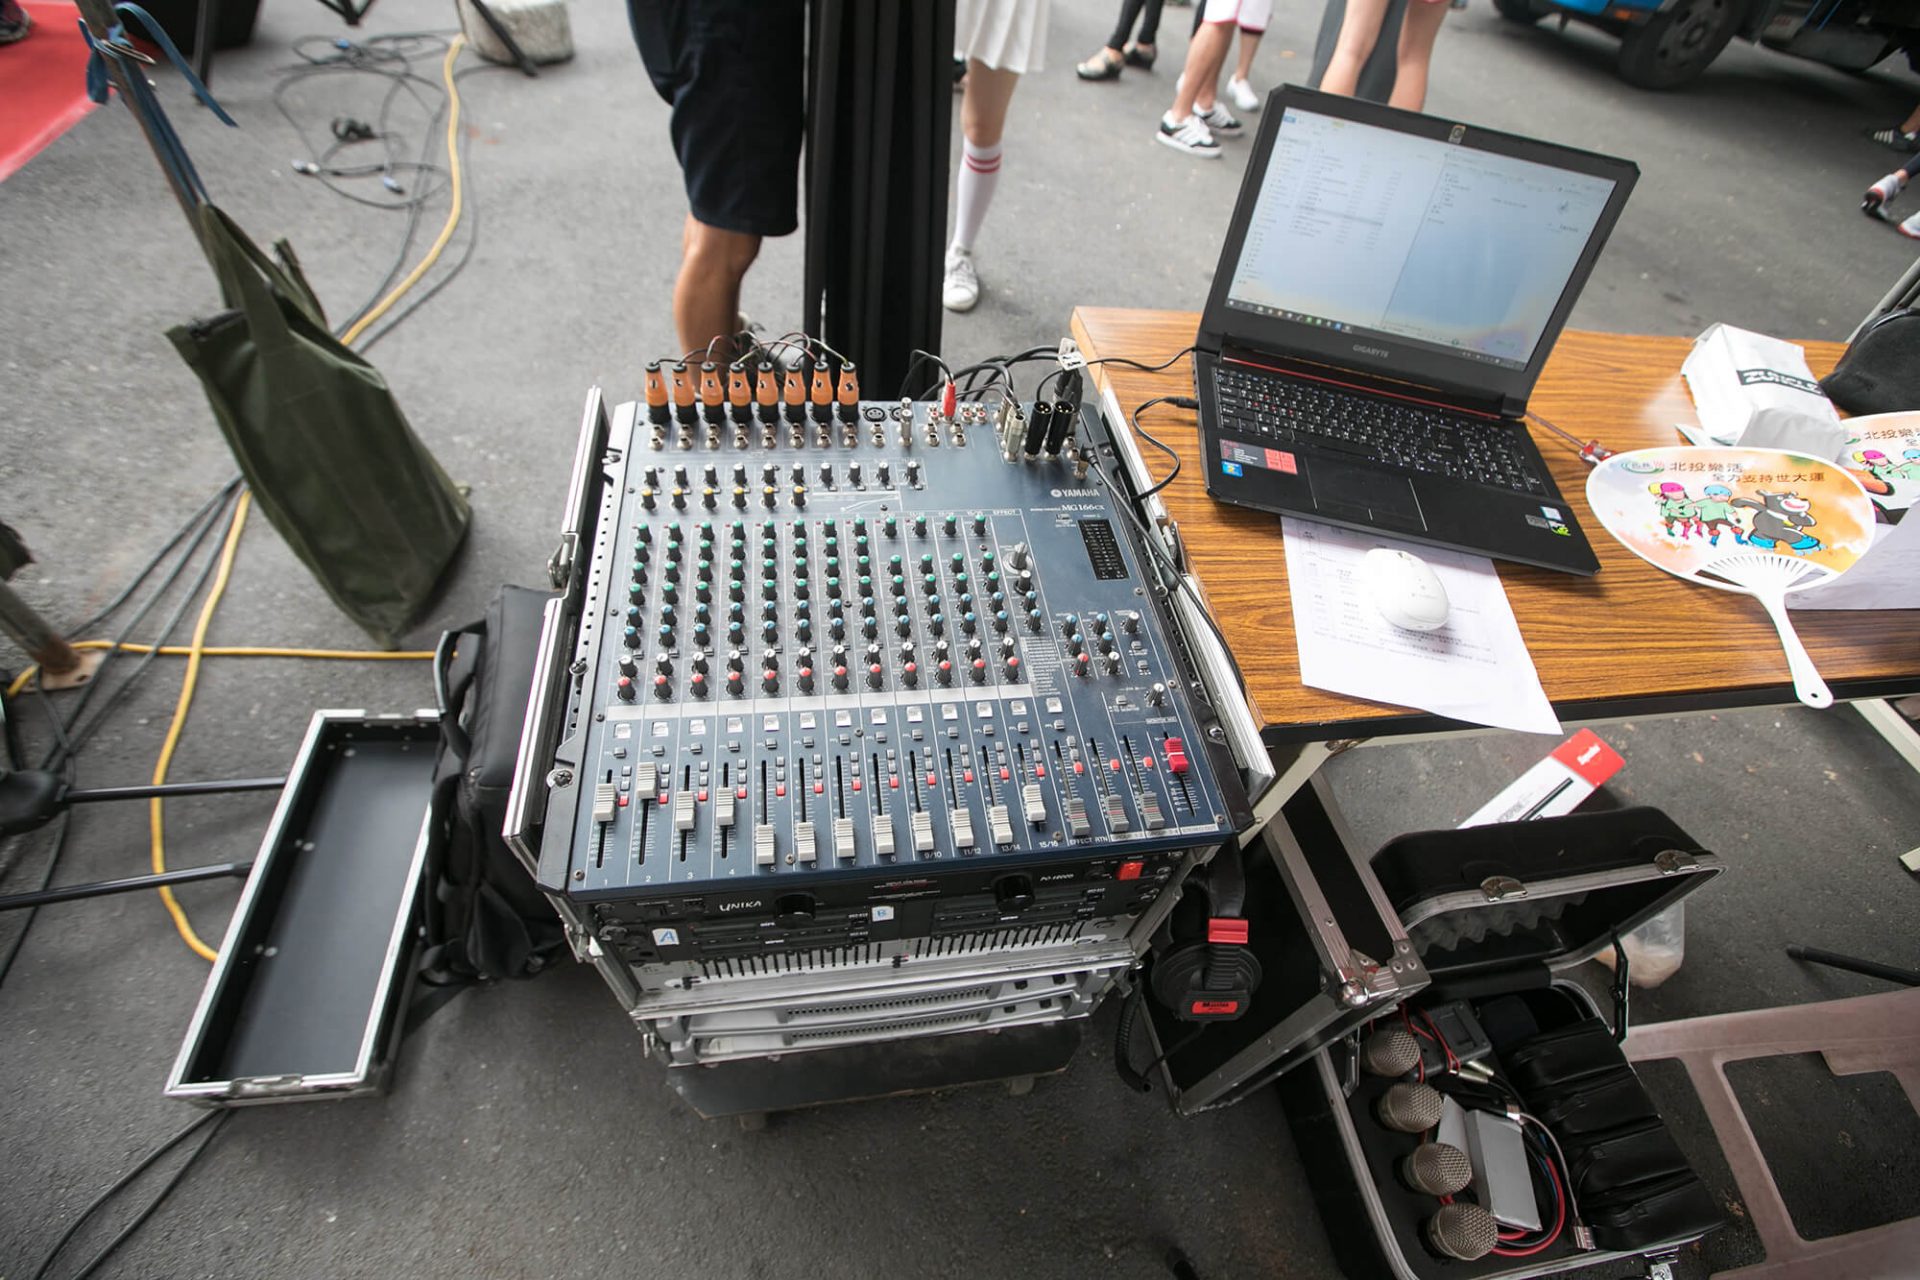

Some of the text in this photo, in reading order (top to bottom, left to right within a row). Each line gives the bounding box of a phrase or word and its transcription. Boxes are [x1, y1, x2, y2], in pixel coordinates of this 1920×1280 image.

[1061, 488, 1100, 497] YAMAHA
[719, 900, 762, 911] UNIKA
[659, 929, 676, 943] A
